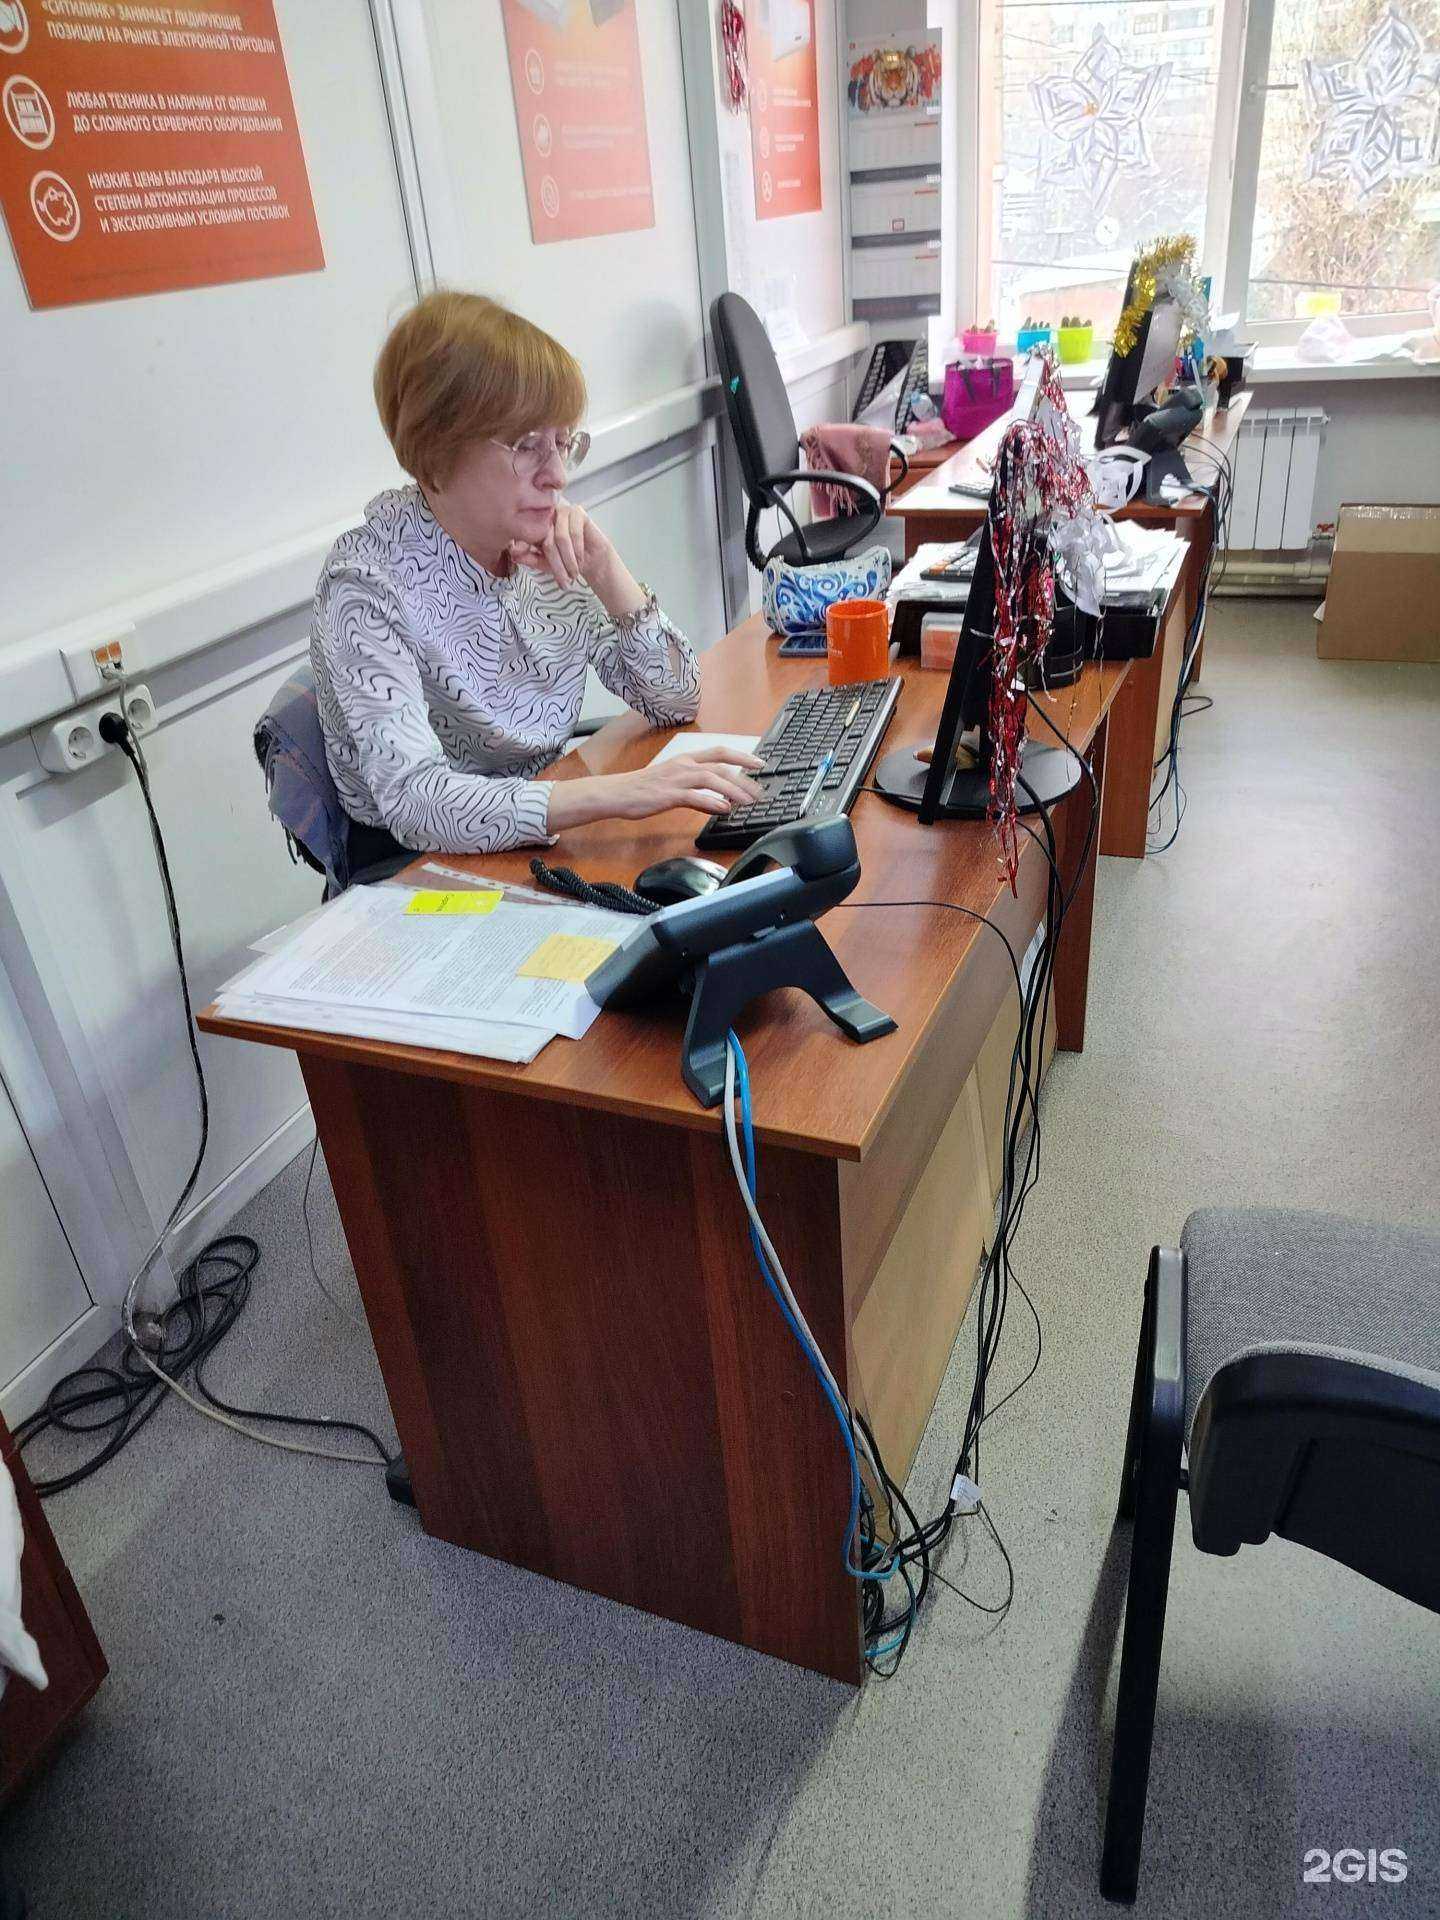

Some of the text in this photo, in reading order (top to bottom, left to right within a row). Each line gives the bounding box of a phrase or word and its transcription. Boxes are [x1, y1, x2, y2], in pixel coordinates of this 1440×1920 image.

[46, 20, 276, 54] ПОЗИЦИИ НА РЫНКЕ ЭЛЕКТРОННОЙ ТОРГОВЛИ
[66, 91, 268, 112] ЛЮБАЯ ТЕХНИКА В НАЛИЧИИ ОТ ФЛЕШКИ
[73, 114, 283, 134] ДО СЛОЖНОГО СЕРВЕРНОГО ОБОРУДОВАНИЯ
[87, 164, 264, 189] НИЗКИЕ ЦЕНЫ БЛАГОДАРЯ ВЫСОКОЙ
[94, 185, 278, 212] СТЕПЕНИ АВТОМАТИЗАЦИИ ПРОЦЕССОВ
[100, 204, 291, 233] И ЭКСКЛЮЗИВНЫМ УСЛОВИЯМ ПОСТАВОК
